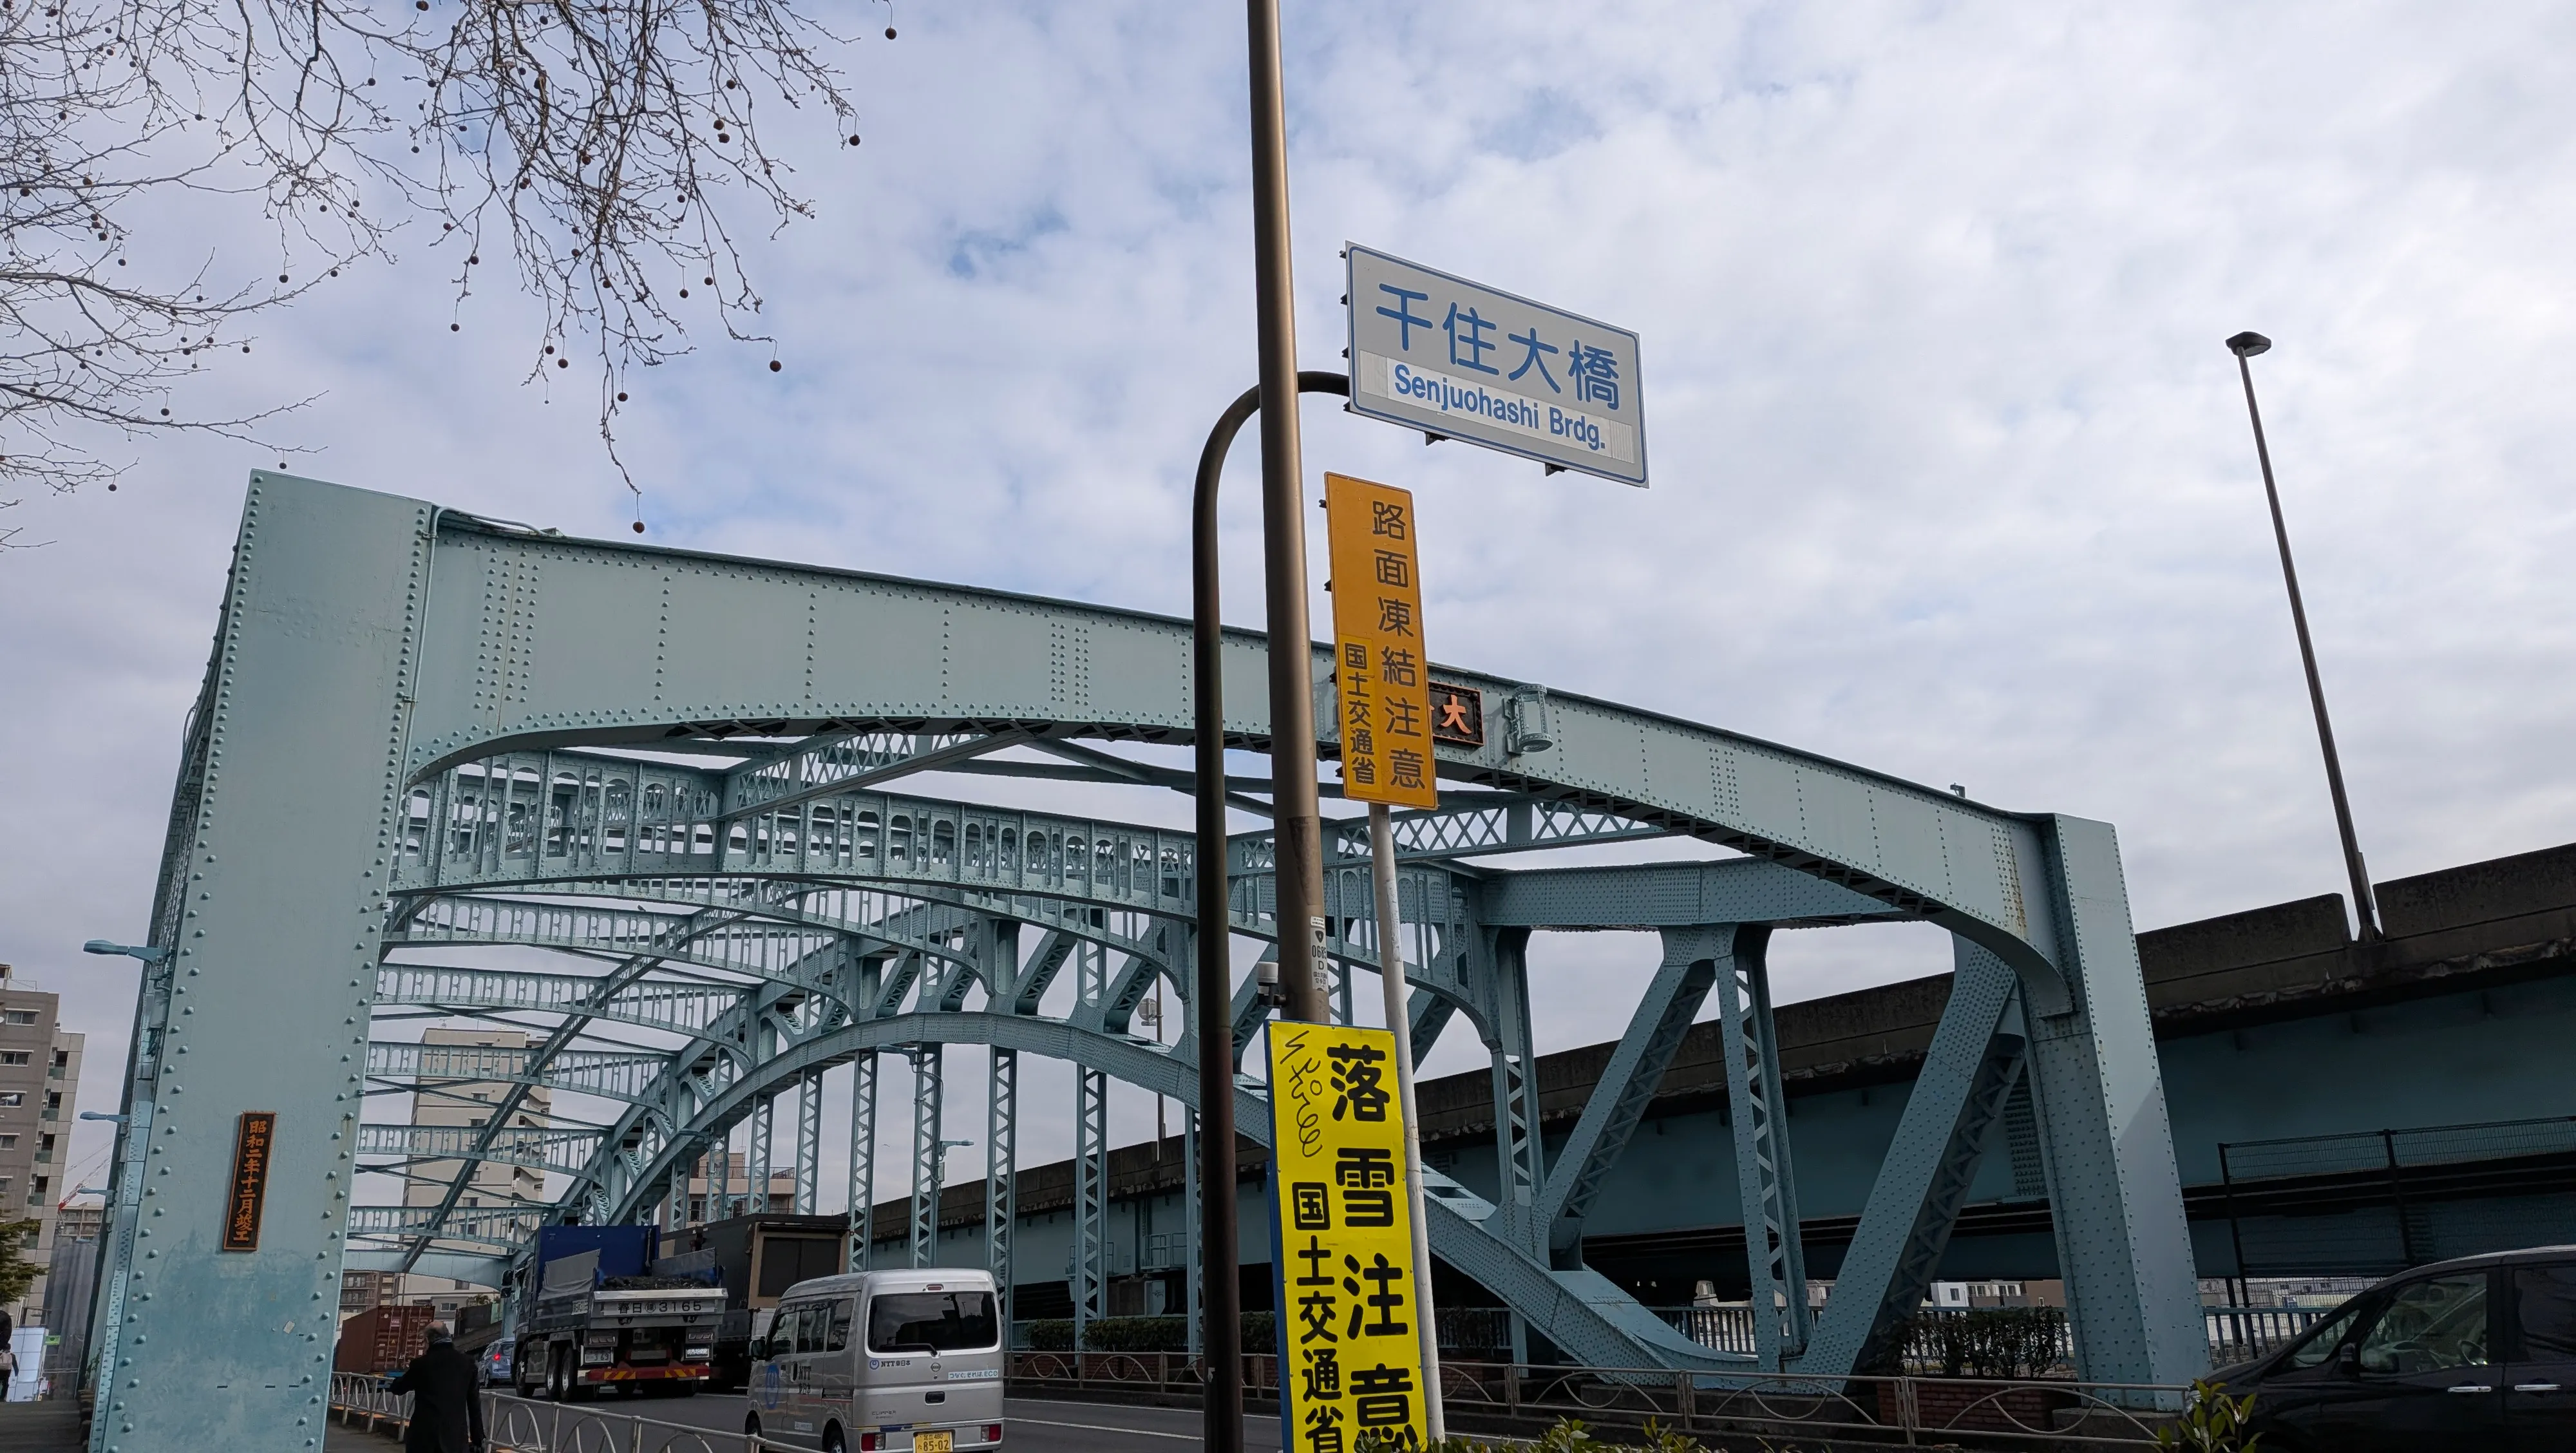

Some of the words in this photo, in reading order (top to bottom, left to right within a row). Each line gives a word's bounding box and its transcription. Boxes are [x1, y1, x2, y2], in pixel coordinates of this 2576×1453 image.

[1376, 283, 1619, 410] 千住大橋
[1395, 364, 1539, 430] Senjuohashi
[1549, 406, 1606, 451] Brdg.
[1372, 499, 1425, 790] 路面凍結注意
[1344, 641, 1376, 786] 国土交通省
[1318, 960, 1324, 970] D
[233, 1119, 267, 1242] 昭和二年十二月竣工
[1327, 1043, 1418, 1450] 落雪注意
[1292, 1181, 1344, 1453] 国土交通省
